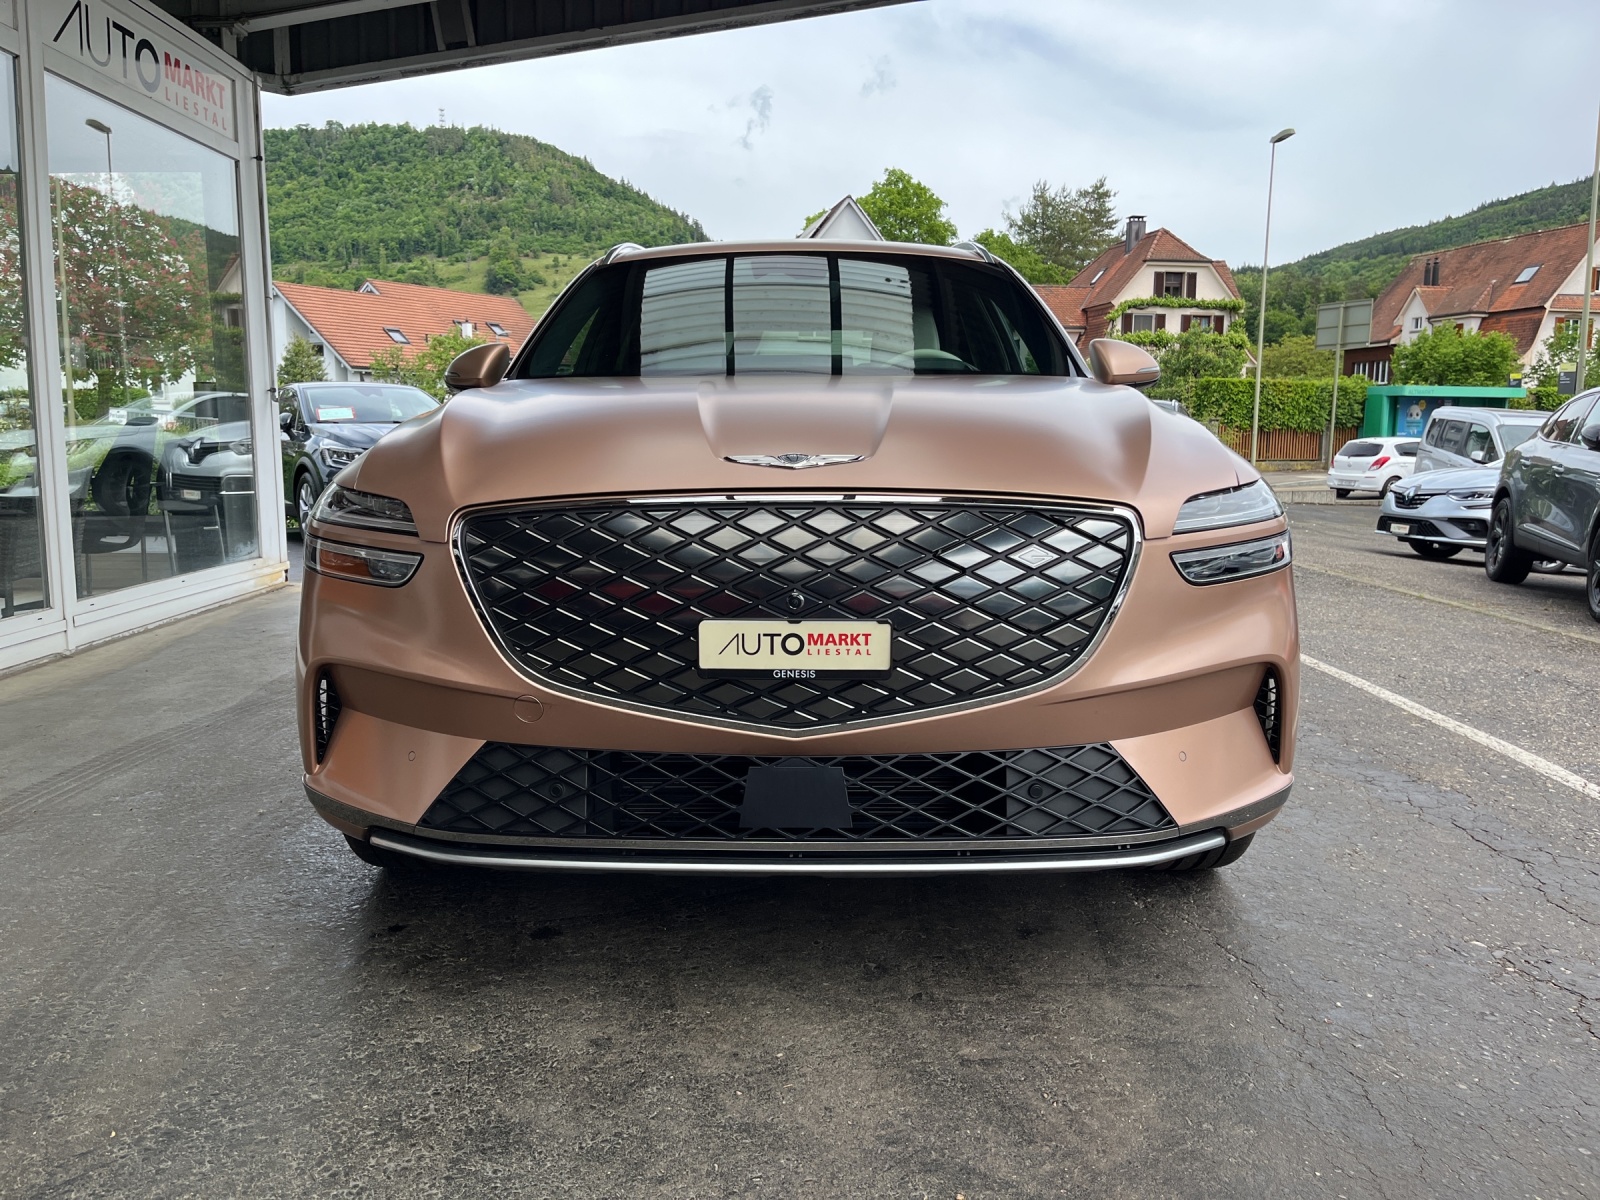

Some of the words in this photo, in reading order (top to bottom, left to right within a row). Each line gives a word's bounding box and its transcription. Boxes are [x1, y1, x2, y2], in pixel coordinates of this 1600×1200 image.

[164, 51, 226, 110] MARKT
[165, 86, 228, 132] LIESTAL
[807, 633, 872, 646] MARKT
[807, 648, 872, 656] LIESTAL
[772, 670, 816, 679] GENESIS
